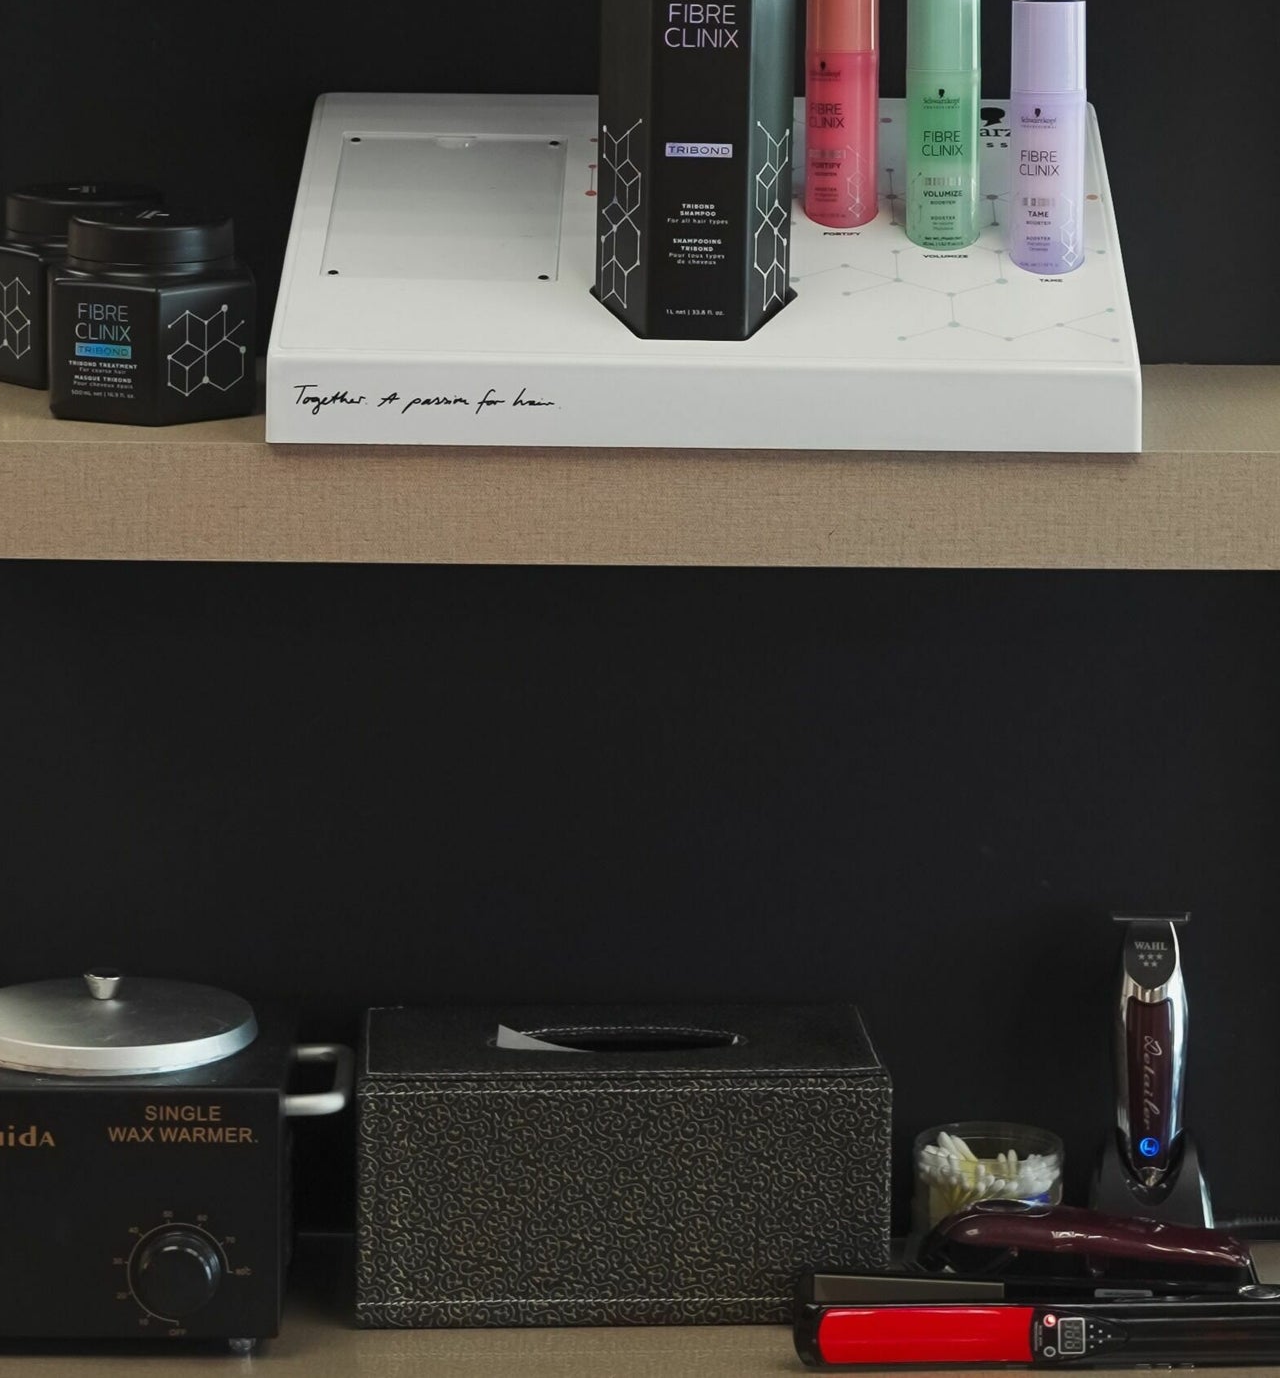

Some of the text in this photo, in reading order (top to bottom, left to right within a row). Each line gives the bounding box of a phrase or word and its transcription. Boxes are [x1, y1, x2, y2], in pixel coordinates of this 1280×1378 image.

[669, 3, 736, 25] FIBRE
[664, 27, 739, 49] CLINIX
[810, 103, 842, 116] FIBRE
[809, 117, 845, 129] CLINIX
[923, 130, 961, 143] FIBRE
[668, 145, 730, 155] TRIBOND
[921, 144, 963, 157] CLINIX
[1020, 150, 1057, 163] FIBRE
[1019, 163, 1060, 177] CLINIX
[923, 190, 963, 198] VOLUMIZE
[1028, 210, 1049, 218] TAME
[78, 302, 128, 322] FIBRE
[75, 322, 131, 342] CLINIX
[78, 345, 129, 357] TRIBOND
[99, 362, 138, 370] TREATMENT
[74, 374, 100, 382] MASQUE
[377, 392, 400, 407] A
[402, 395, 470, 414] passion
[476, 389, 505, 414] for
[1134, 941, 1168, 951] WAHL
[1143, 1035, 1163, 1131] Detailer
[145, 1105, 222, 1121] SINGLE
[108, 1126, 155, 1142] WAX
